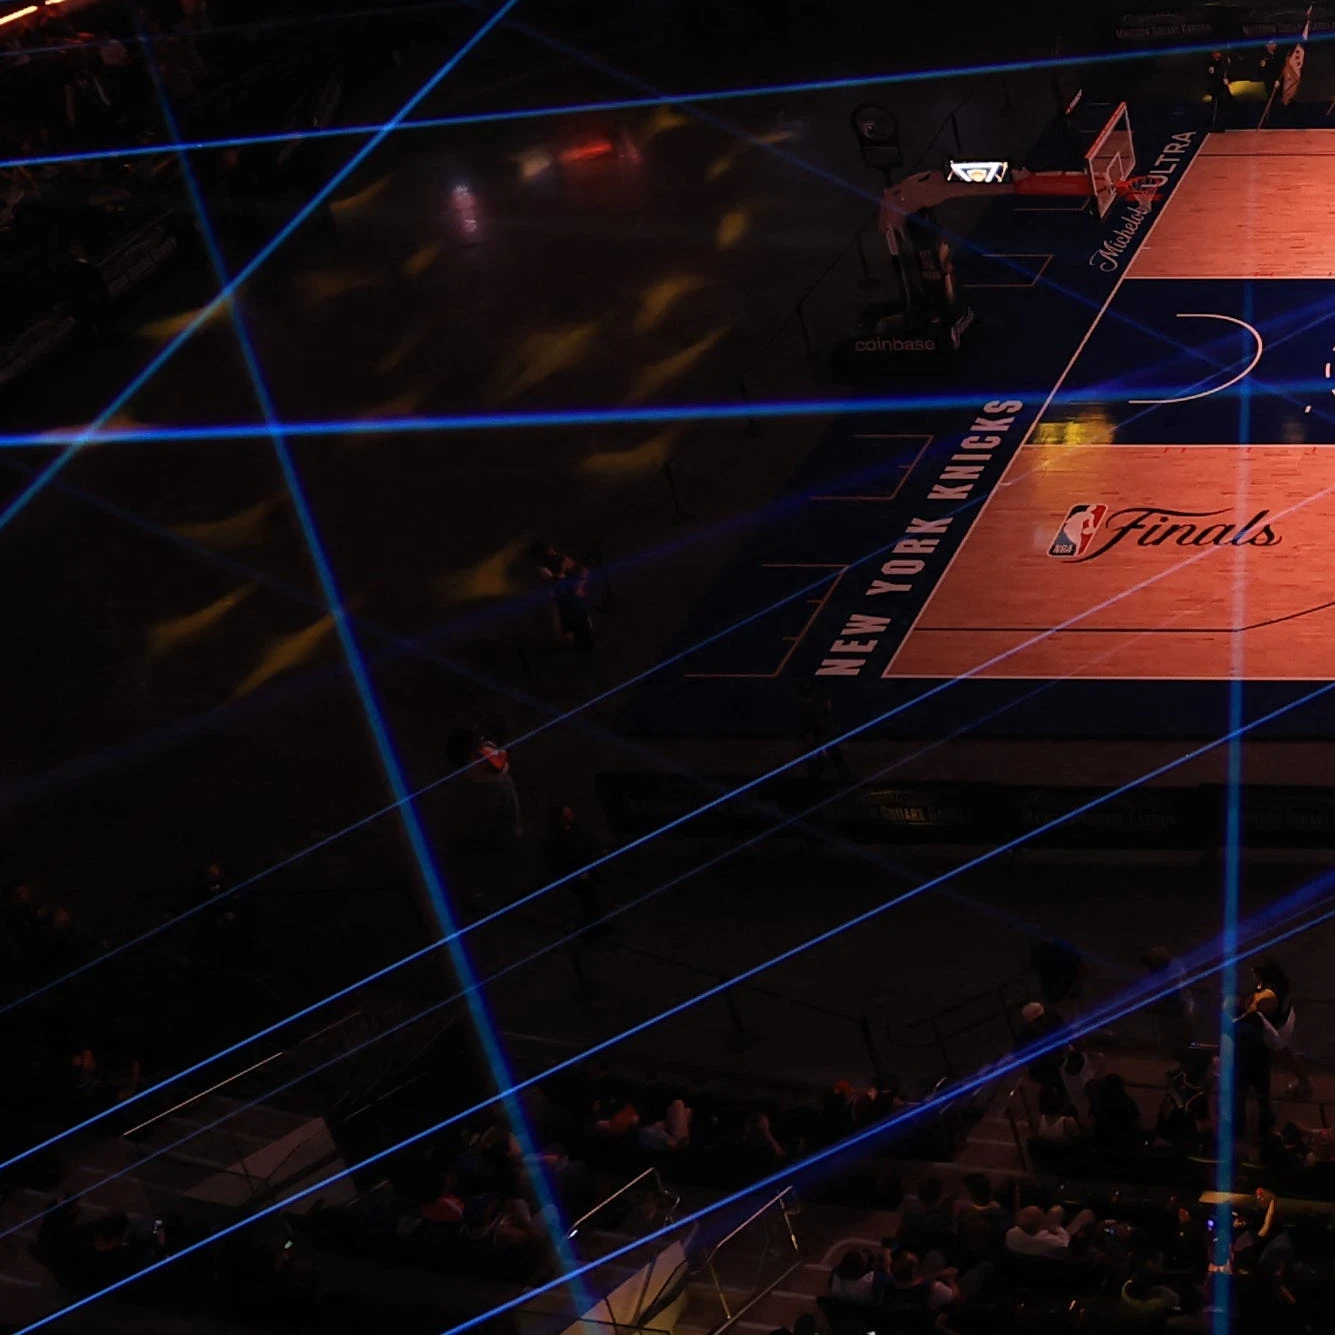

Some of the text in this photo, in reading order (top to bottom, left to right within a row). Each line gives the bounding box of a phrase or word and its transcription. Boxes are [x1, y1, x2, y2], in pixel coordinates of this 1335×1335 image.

[1141, 130, 1198, 189] ULTRA
[855, 336, 937, 353] coinbase
[815, 400, 1023, 676] NEW YORK KNICKS
[1062, 507, 1283, 563] Finals
